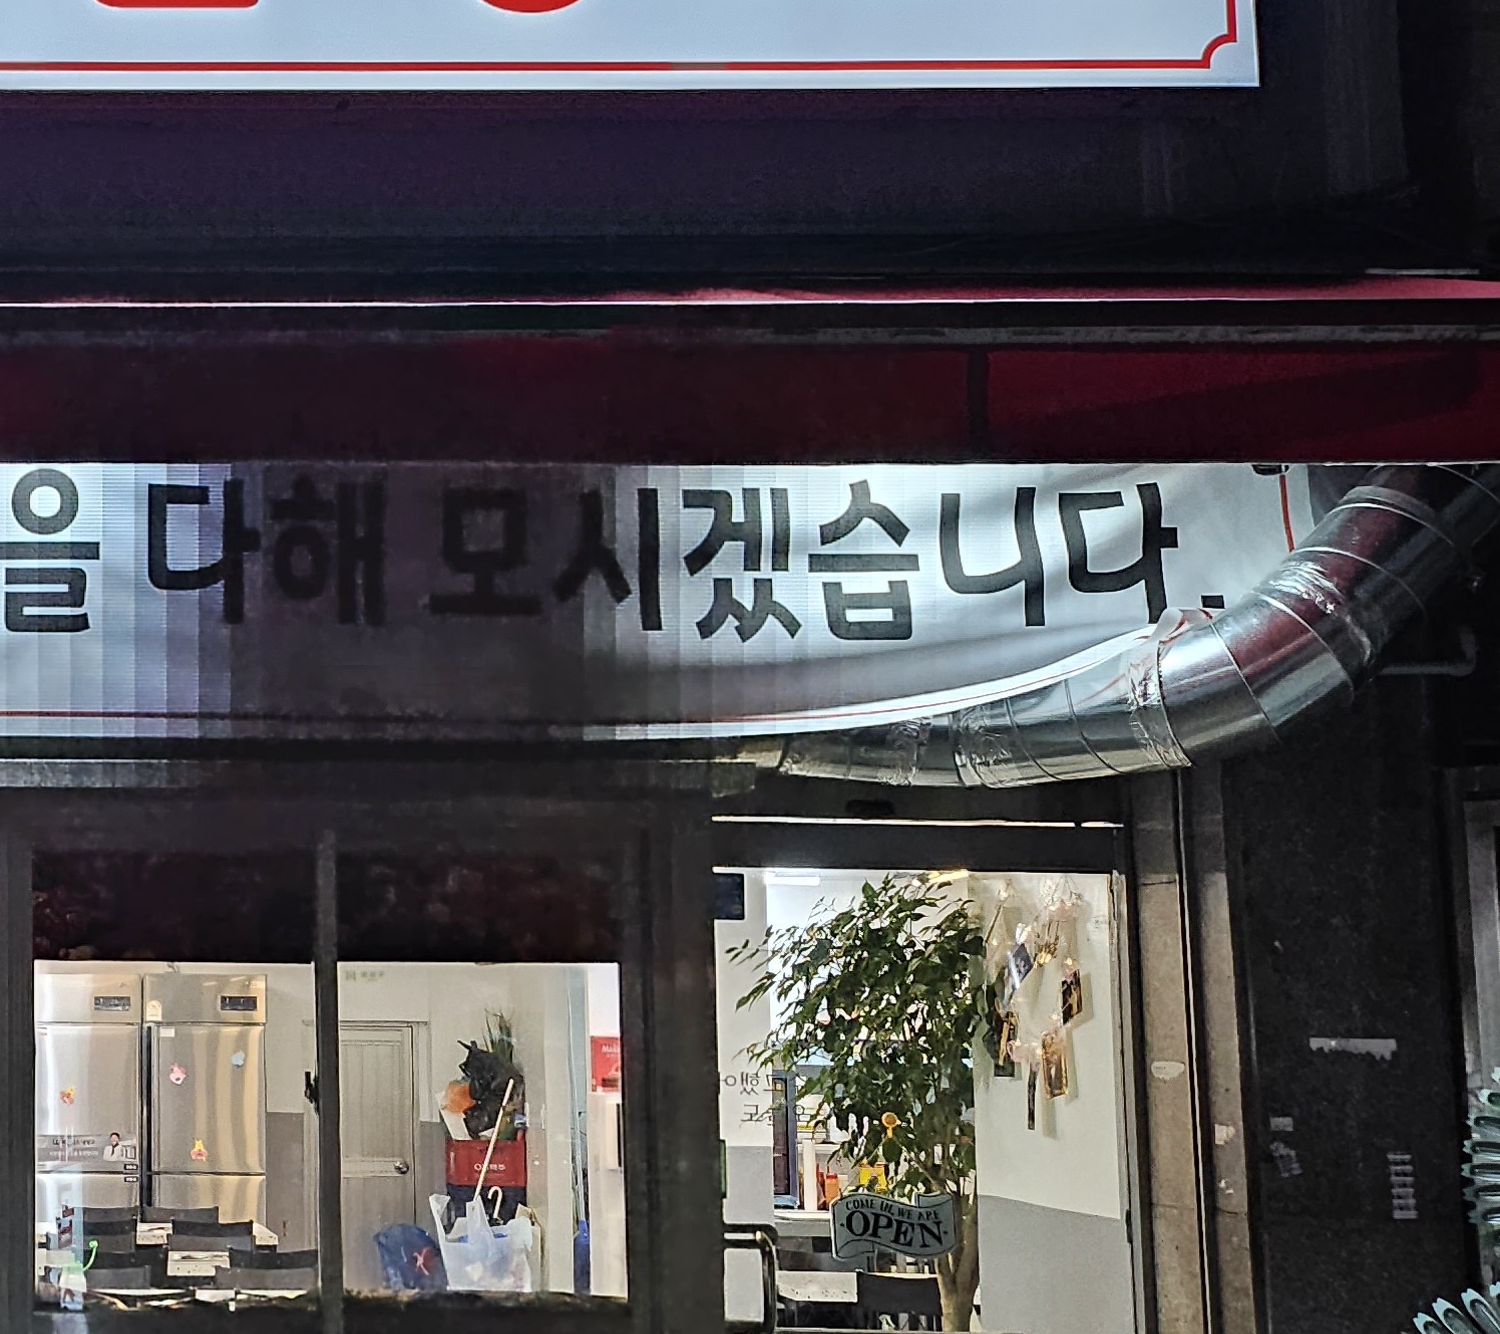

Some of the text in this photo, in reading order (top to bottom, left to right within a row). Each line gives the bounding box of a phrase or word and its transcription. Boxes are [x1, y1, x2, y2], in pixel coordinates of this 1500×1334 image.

[147, 478, 386, 627] 다해
[418, 478, 1226, 643] 모시겠습니다.
[845, 1209, 943, 1248] OPEN
[846, 1199, 875, 1211] COME
[918, 1210, 940, 1221] ARE
